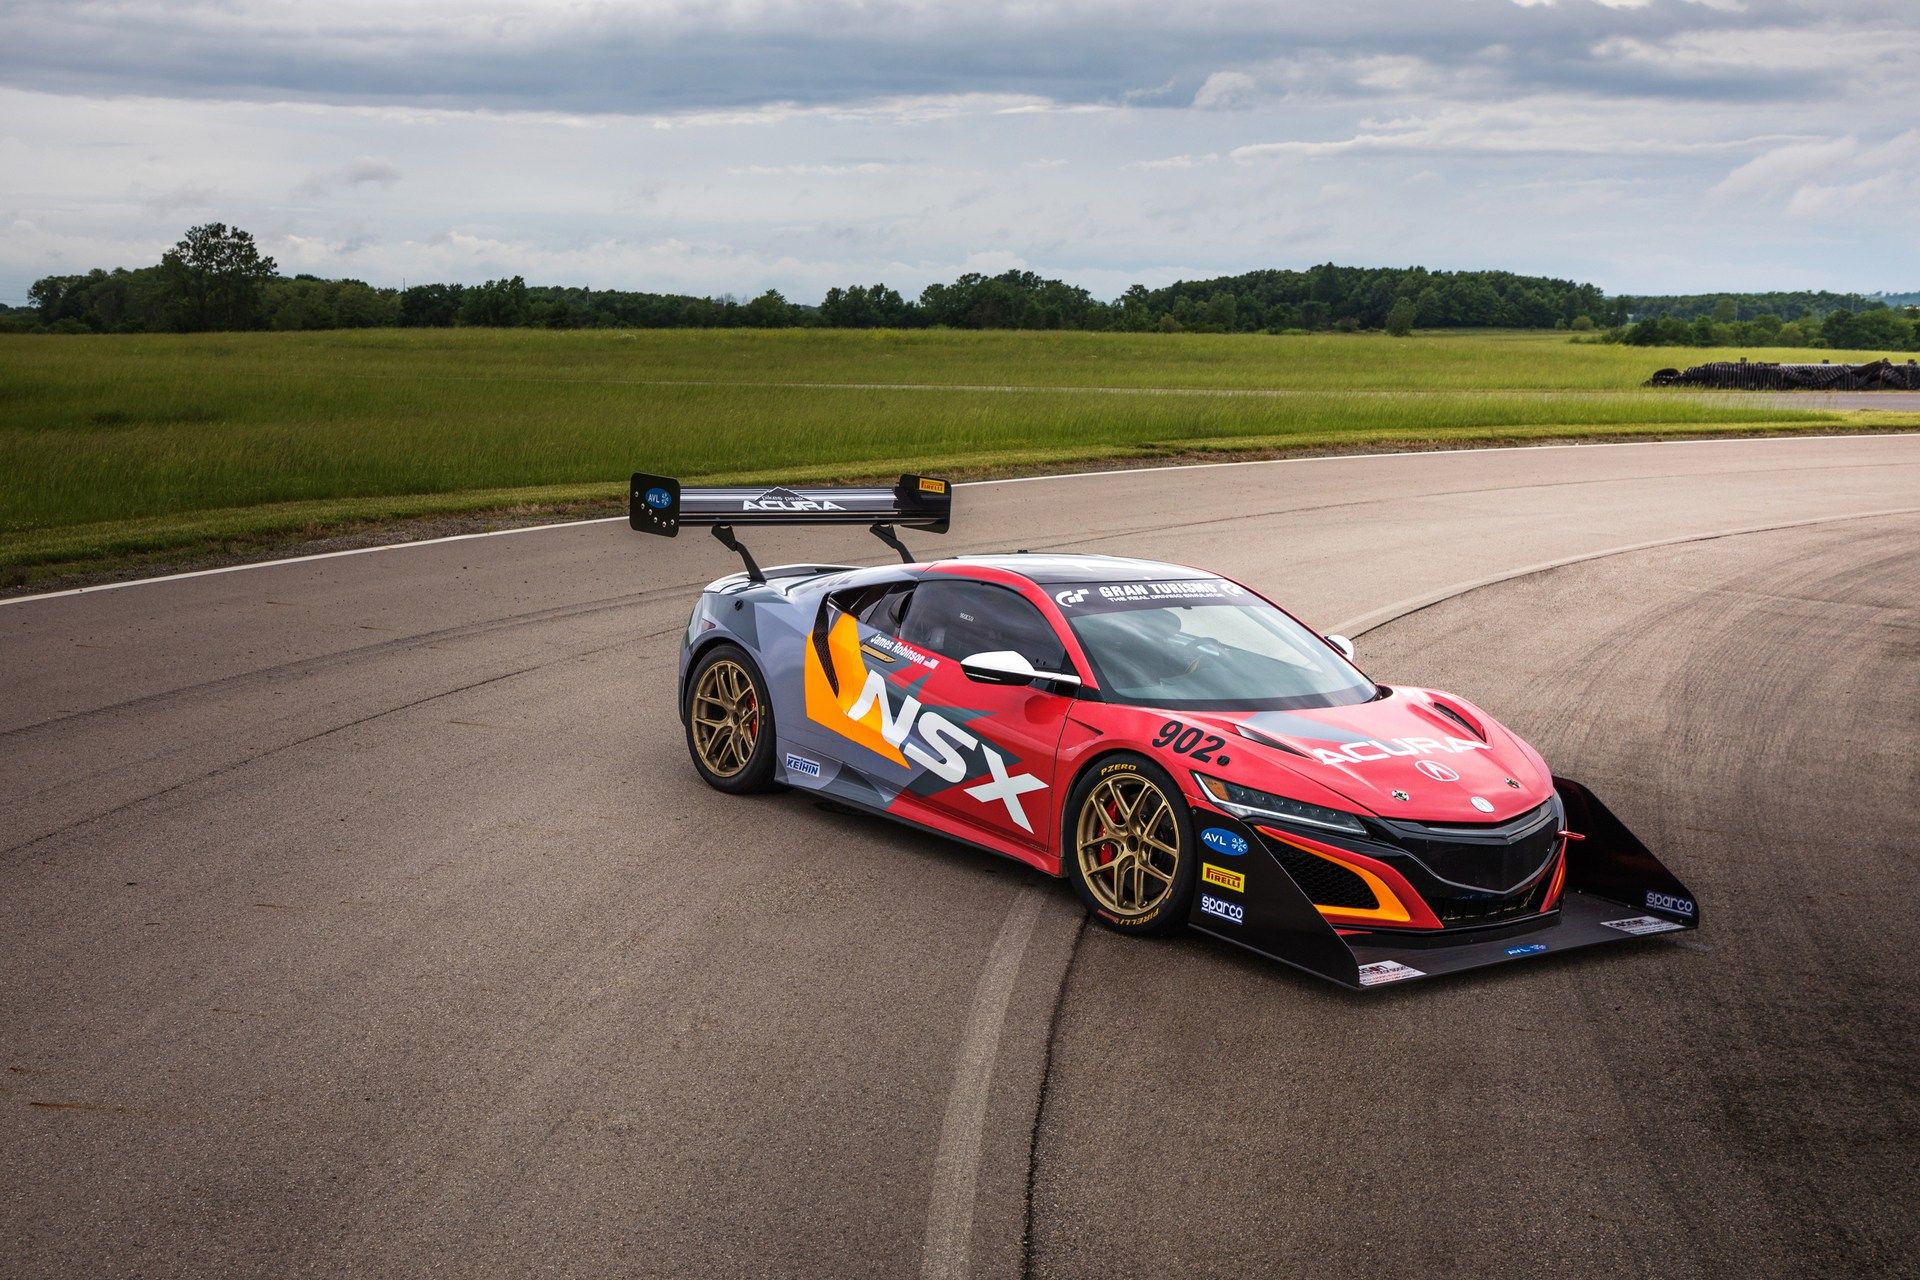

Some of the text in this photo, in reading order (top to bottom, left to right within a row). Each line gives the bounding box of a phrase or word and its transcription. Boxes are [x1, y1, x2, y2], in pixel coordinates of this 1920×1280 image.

[648, 493, 660, 503] AVL
[743, 500, 847, 511] ACURA
[1099, 582, 1217, 598] GRAN TURISMO
[870, 634, 926, 665] James Robinson
[847, 669, 1050, 835] NSX
[1311, 736, 1494, 766] ACURA
[786, 757, 819, 776] KEIHIN
[1203, 831, 1227, 847] AVL
[1205, 867, 1241, 889] PIRELLI
[1202, 896, 1243, 919] sparco
[1645, 892, 1693, 912] sparco
[1120, 907, 1160, 926] PIRELLI
